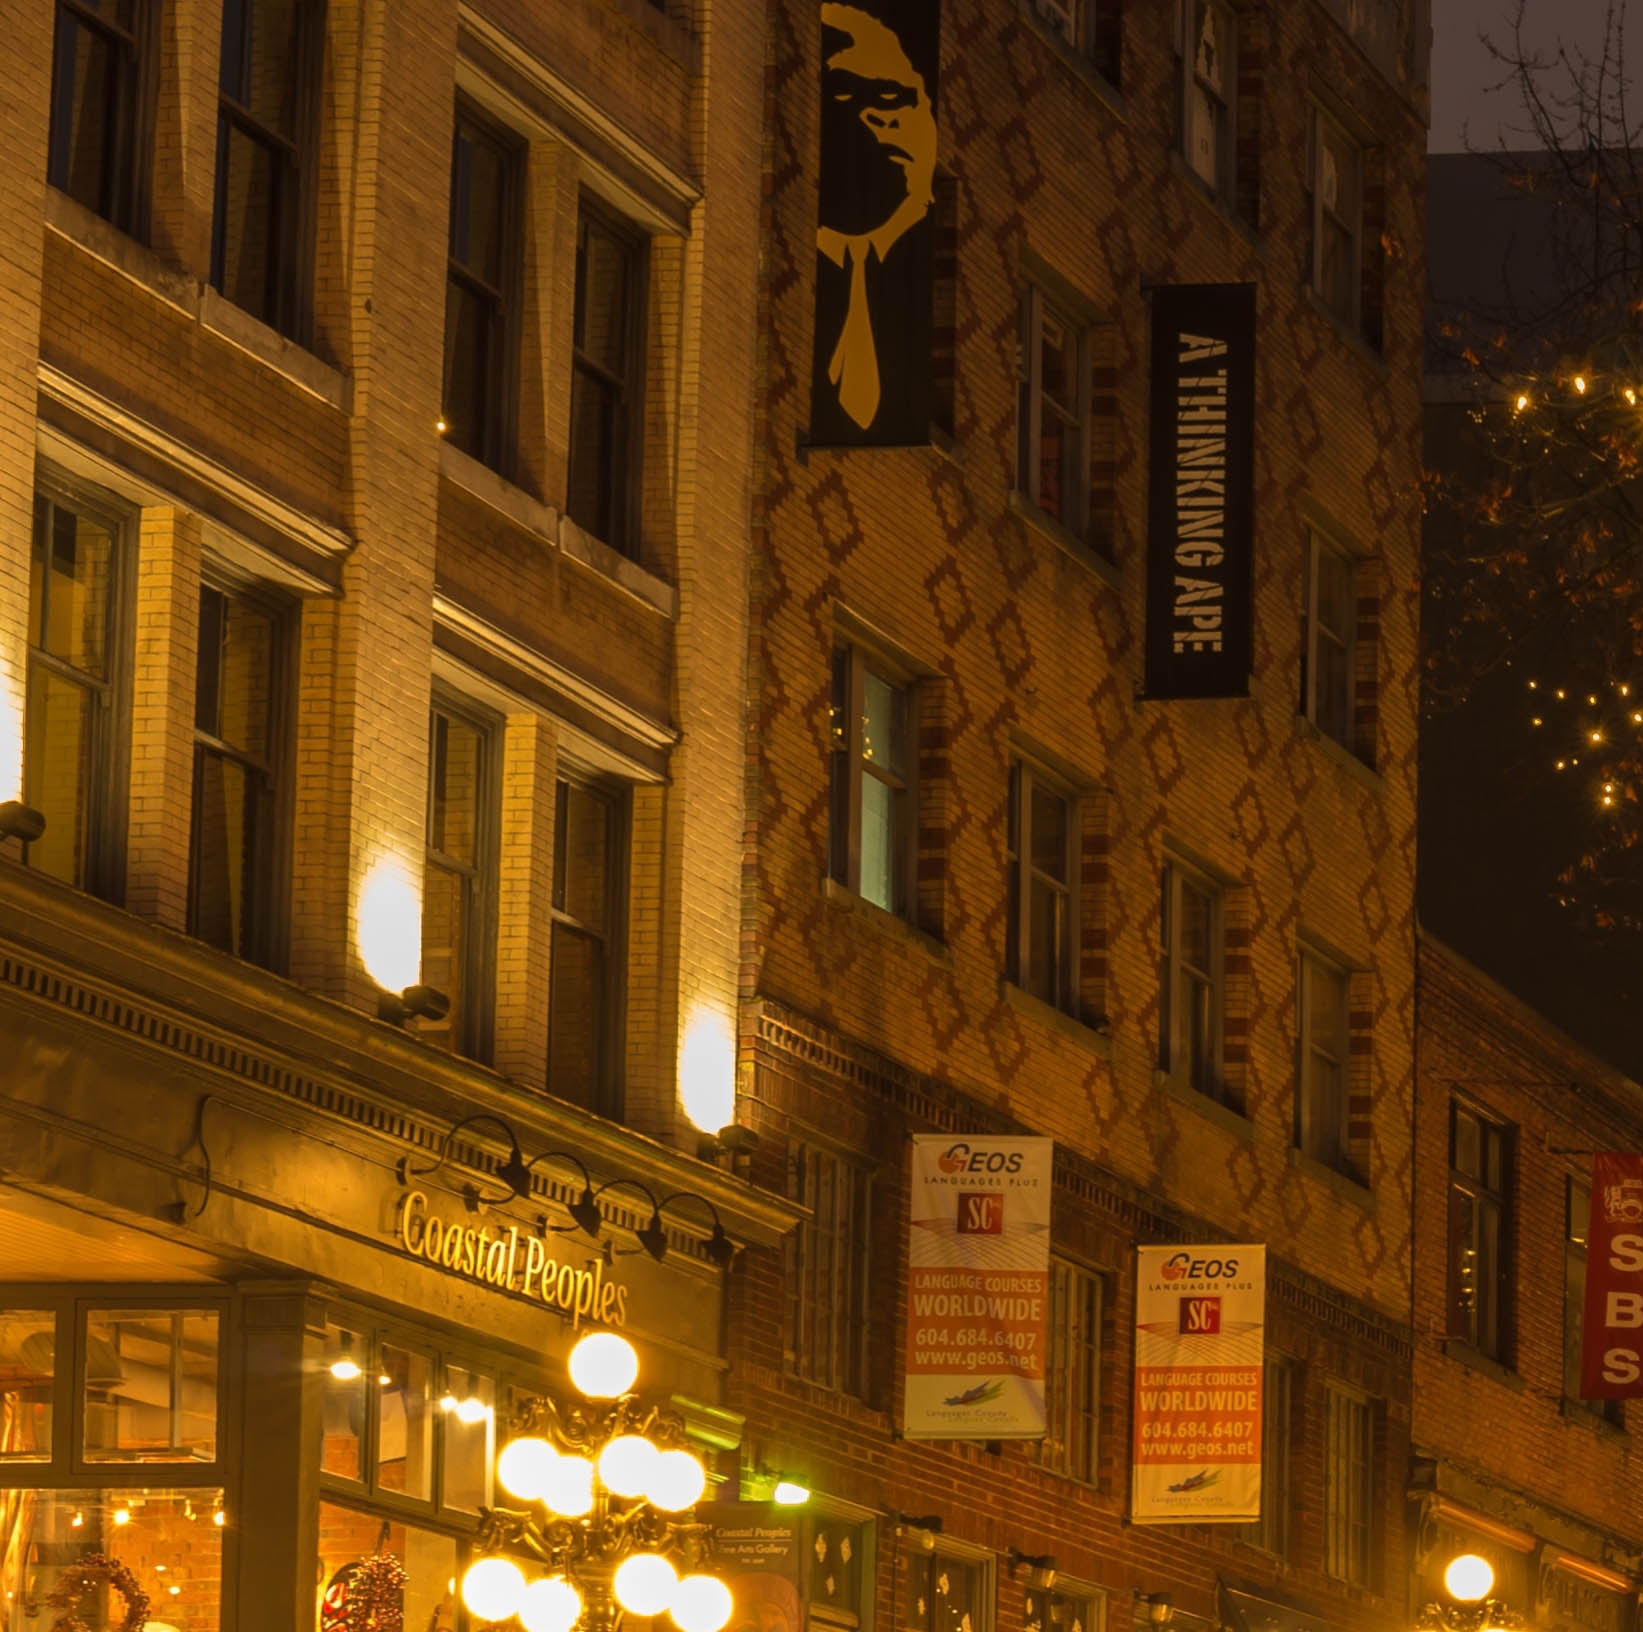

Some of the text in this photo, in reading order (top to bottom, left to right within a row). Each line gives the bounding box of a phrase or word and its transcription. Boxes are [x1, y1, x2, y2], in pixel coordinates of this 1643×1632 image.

[1173, 332, 1228, 654] A THINKING APE
[937, 1143, 1024, 1174] GEOS
[924, 1176, 1039, 1188] LANGUAGES PLUS
[967, 1197, 993, 1230] SC
[402, 1190, 628, 1331] Coastal Peoples
[1160, 1252, 1239, 1281] GEOS
[914, 1273, 1042, 1294] LANGUAGE COURSES
[1148, 1282, 1253, 1291] LANGUAGES PLUS
[913, 1293, 1041, 1322] WORLDWIDE
[1188, 1300, 1211, 1331] SC
[915, 1327, 1037, 1351] 604.684.6407
[914, 1350, 1036, 1371] www.geos.net
[1140, 1372, 1258, 1387] LANGUAGE COURSES
[1139, 1390, 1258, 1412] WORLDWIDE
[1141, 1421, 1254, 1438] 604.684.6407
[1141, 1441, 1254, 1460] www.geos.net
